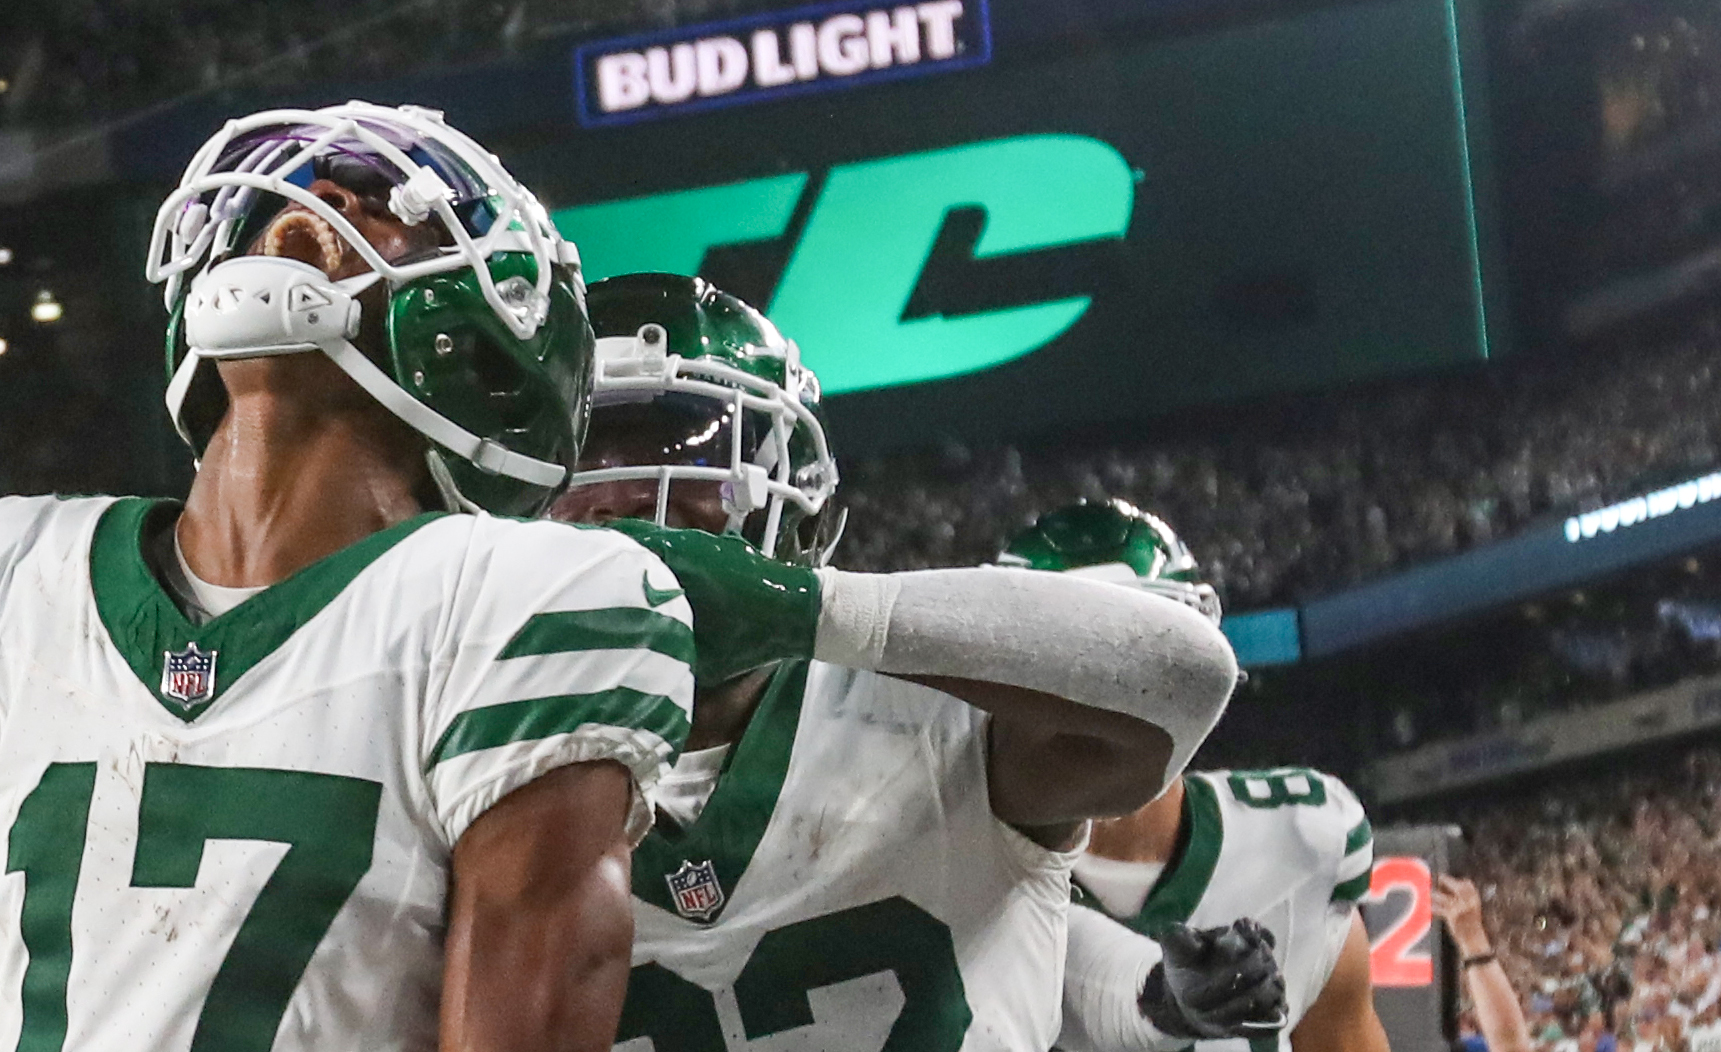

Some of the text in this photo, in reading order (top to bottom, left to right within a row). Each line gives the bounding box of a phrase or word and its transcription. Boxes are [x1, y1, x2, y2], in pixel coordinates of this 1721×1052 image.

[596, 1, 964, 113] BUD LIGHT
[681, 885, 718, 909] NFL
[1369, 856, 1433, 987] 2
